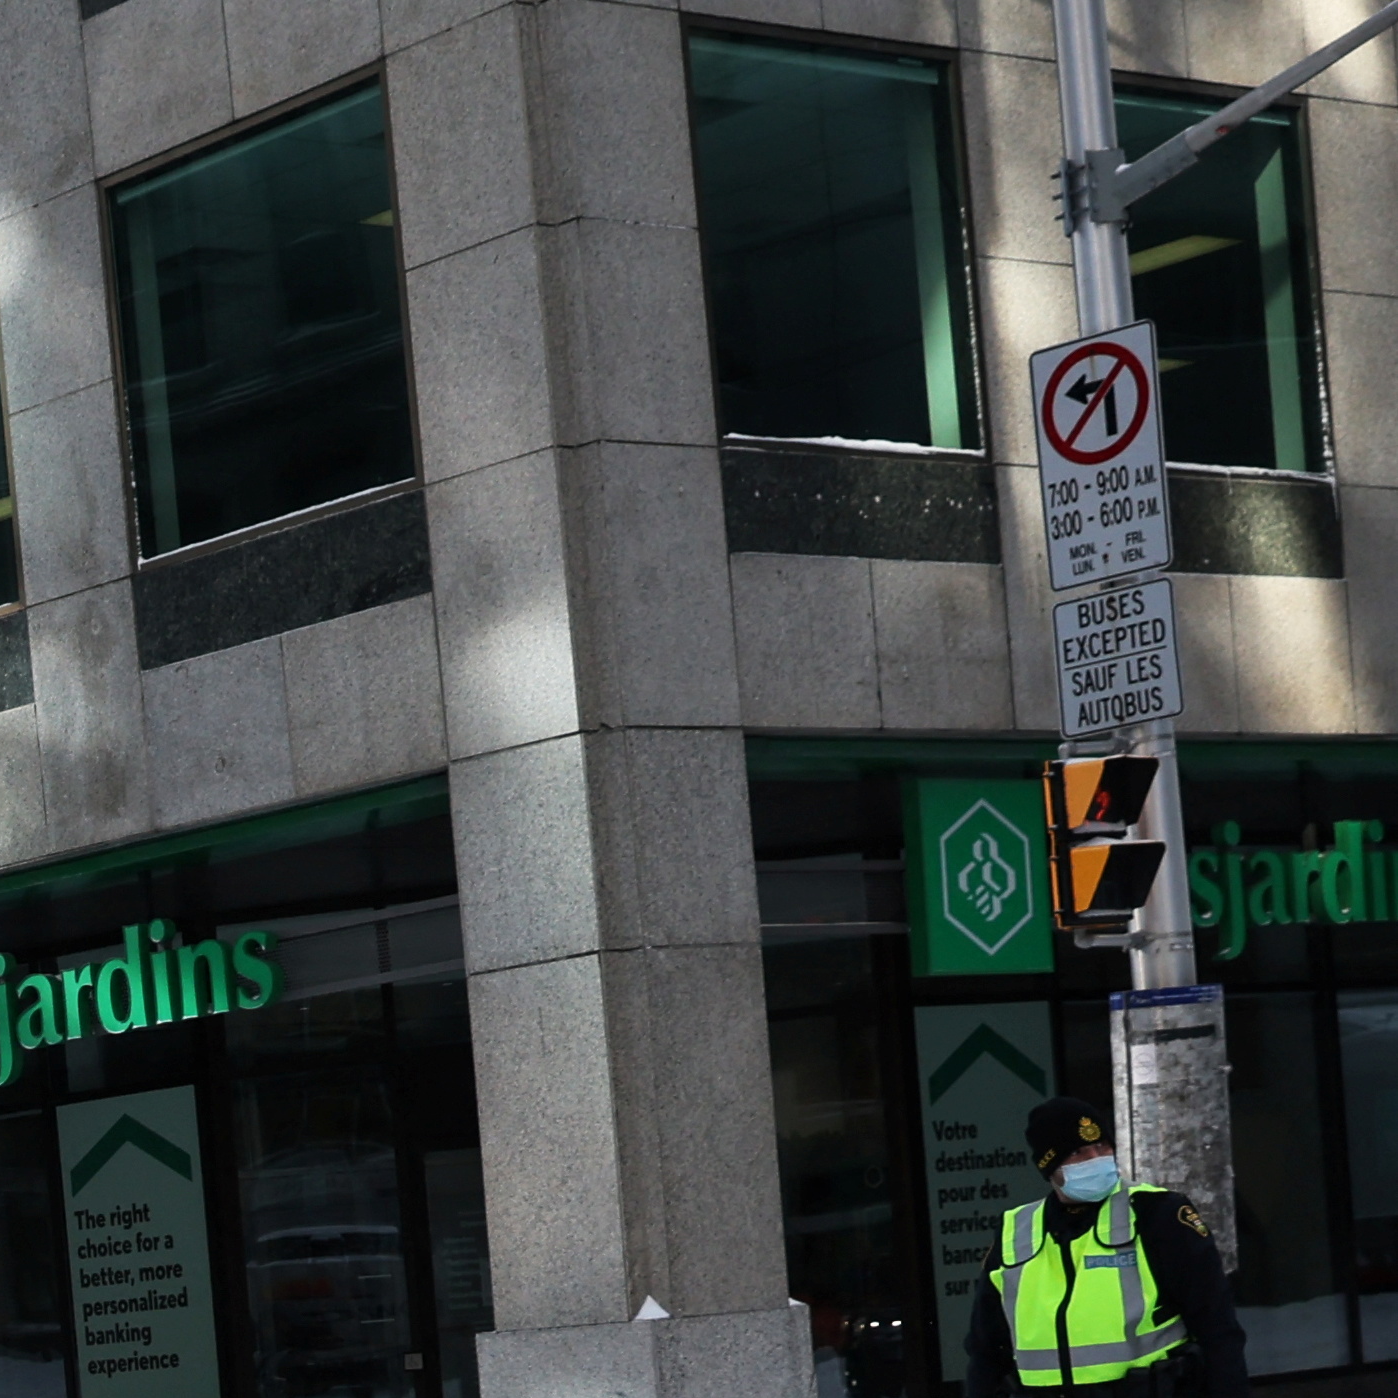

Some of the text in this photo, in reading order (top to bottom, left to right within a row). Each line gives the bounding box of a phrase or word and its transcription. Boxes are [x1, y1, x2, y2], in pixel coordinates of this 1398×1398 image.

[1048, 478, 1079, 508] 7:00
[1096, 465, 1129, 496] 9:00
[1135, 464, 1157, 487] A.M.
[1050, 509, 1082, 540] 3:00
[1100, 497, 1133, 528] 6:00
[1138, 497, 1160, 519] P.M.
[1070, 542, 1097, 560] MON.
[1125, 530, 1146, 546] FRI.
[1072, 547, 1145, 576] LUN. VEN.
[1077, 590, 1145, 629] BUSES
[1062, 617, 1166, 664] EXCEPTED
[1071, 654, 1163, 697] SAUF LES
[1077, 686, 1164, 728] AUTOBUS
[931, 1119, 978, 1142] Votre
[934, 1147, 1027, 1173] destination
[938, 1178, 1009, 1209] pour des
[74, 1203, 150, 1230] The right
[77, 1232, 174, 1260] choice for a
[1086, 1253, 1136, 1267] POLICE
[79, 1263, 183, 1289] better, more
[944, 1279, 970, 1297] sur
[82, 1286, 189, 1322] personalized
[85, 1322, 152, 1347] banking
[87, 1351, 180, 1379] experience
